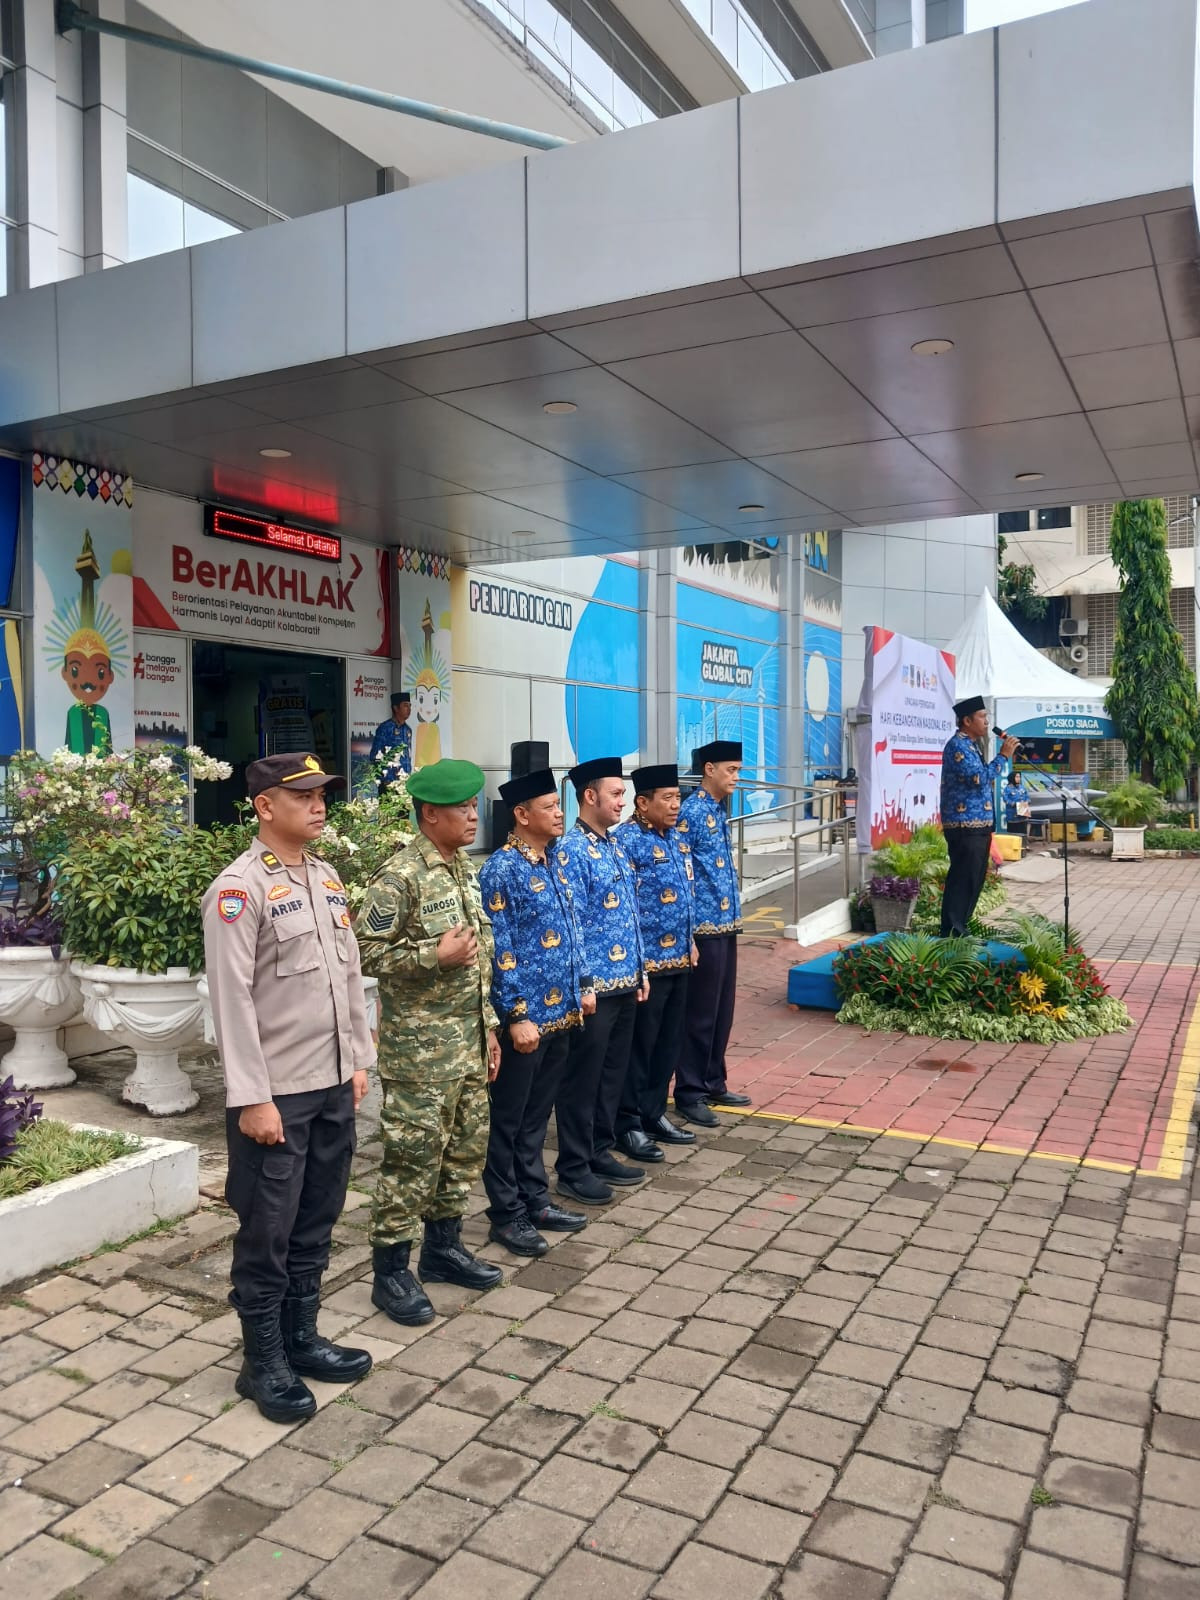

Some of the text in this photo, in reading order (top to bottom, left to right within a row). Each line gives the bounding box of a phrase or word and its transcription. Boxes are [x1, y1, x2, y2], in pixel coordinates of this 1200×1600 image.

[267, 526, 337, 557] Selamat Datang
[172, 545, 356, 613] BerAKHLAK
[172, 591, 356, 629] Berorientasi Pelayanan Akuntabel Kompeten
[470, 580, 572, 631] PENJARINGAN
[172, 605, 321, 635] Harmonis Loyal Adaptif Kolaboratif
[146, 652, 176, 665] bangga
[702, 642, 739, 667] JAKARTA
[146, 664, 182, 675] melayani
[146, 672, 175, 684] bangsa
[702, 662, 753, 686] GLOBAL CITY
[1046, 718, 1099, 729] POSKO SIAGA
[271, 900, 304, 918] ARIEF
[422, 897, 456, 915] SUROSO
